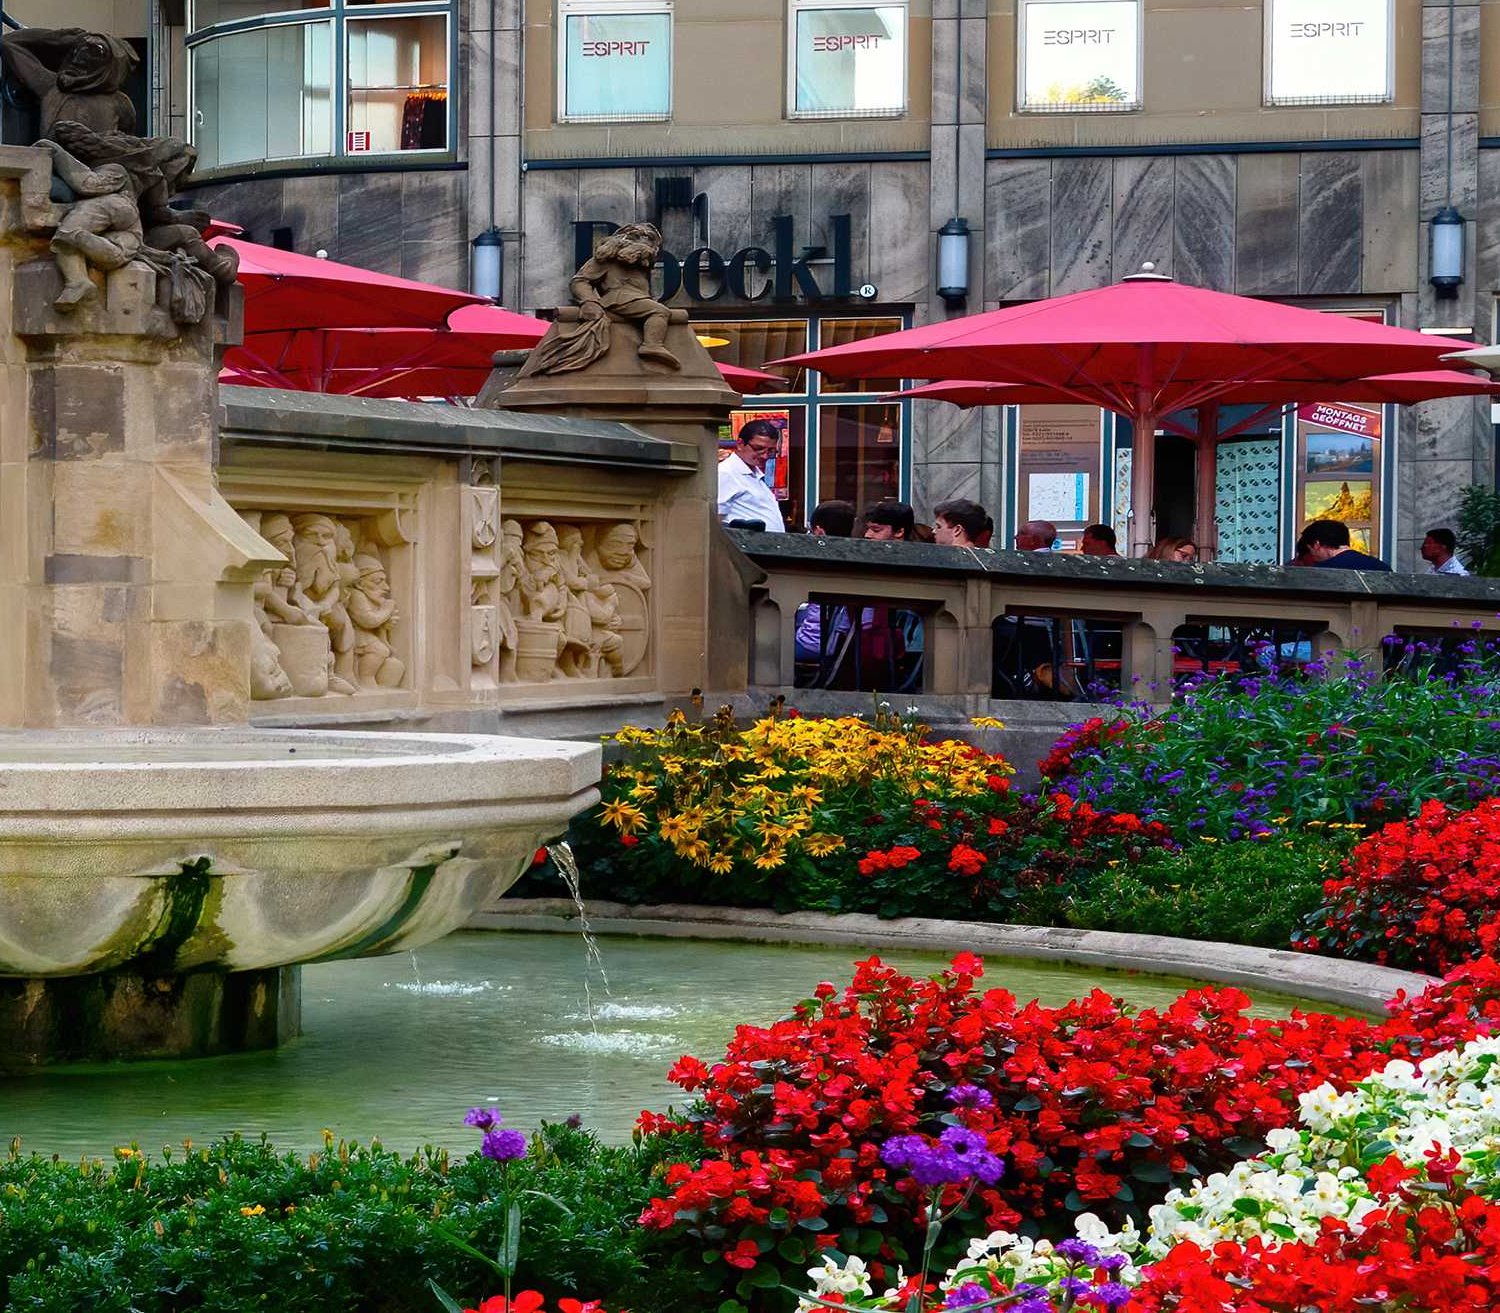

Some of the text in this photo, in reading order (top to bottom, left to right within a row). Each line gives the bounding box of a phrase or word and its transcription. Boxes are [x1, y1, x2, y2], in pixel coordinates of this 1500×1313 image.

[1043, 28, 1116, 46] ESPRIT
[1290, 21, 1365, 38] ESPRIT
[582, 41, 650, 57] ESPRIT
[813, 34, 882, 52] ESPRIT
[1311, 412, 1367, 433] GEÖFFNET
[1316, 405, 1367, 424] MONTAGS
